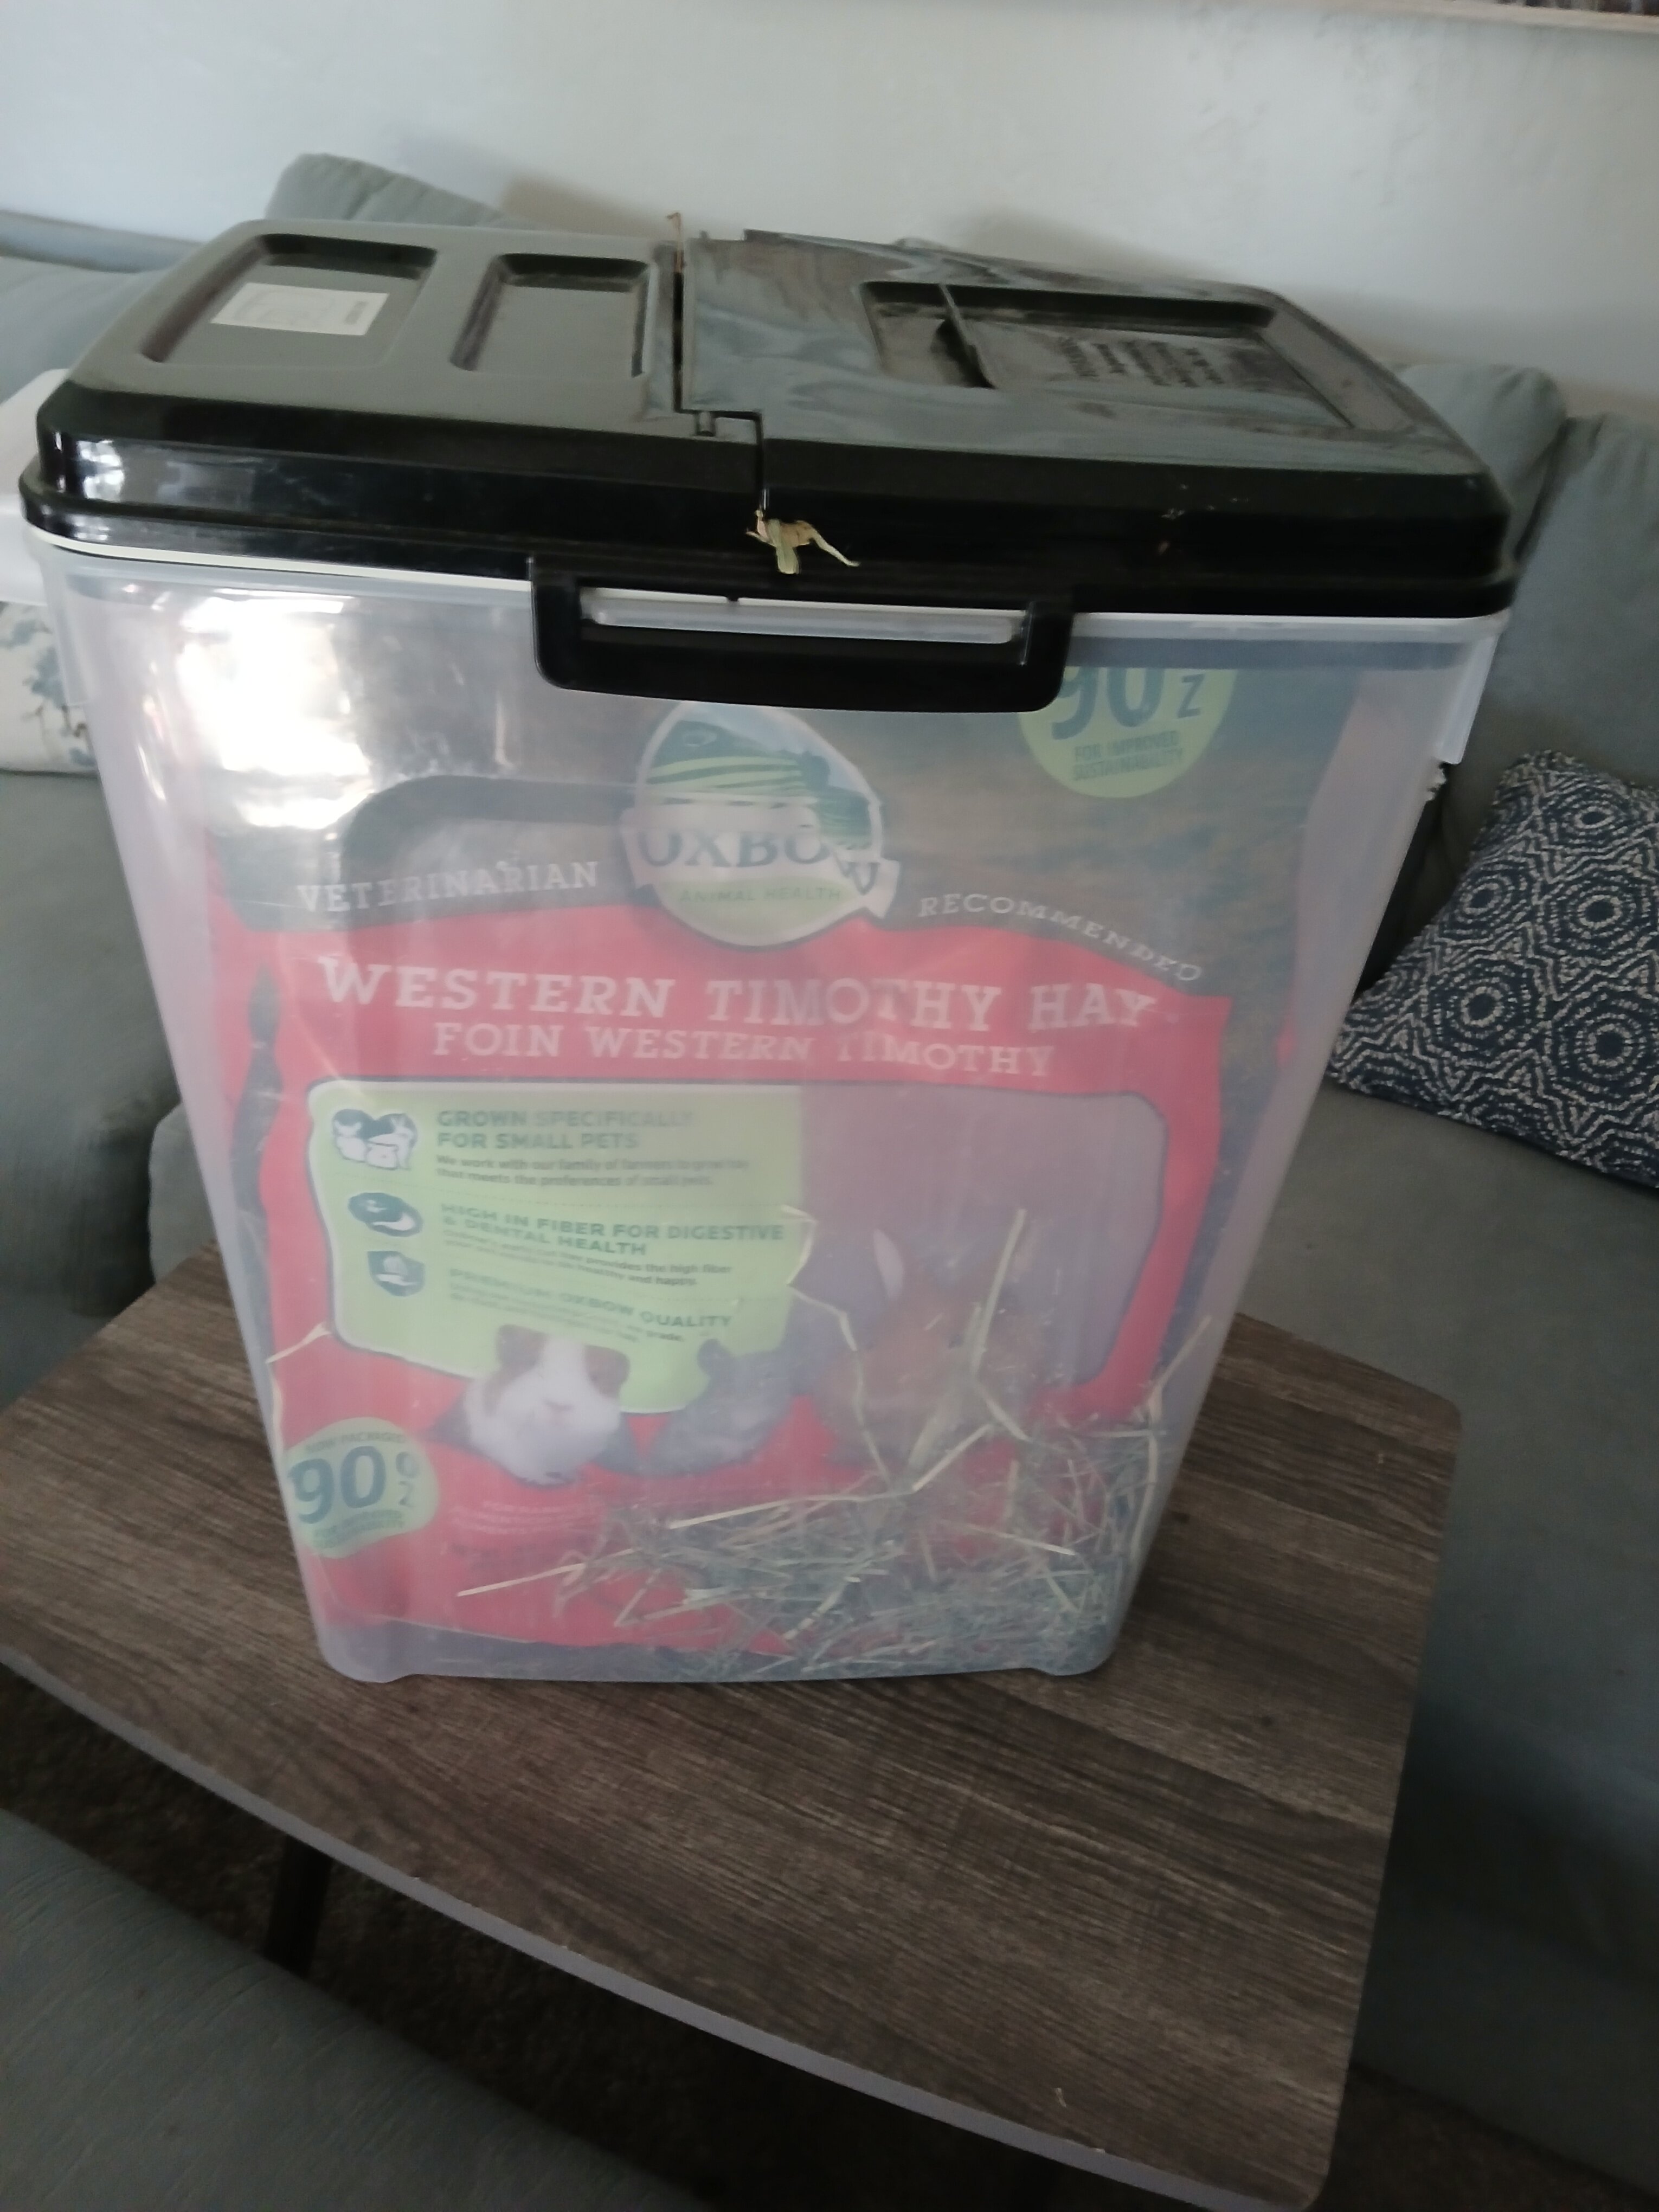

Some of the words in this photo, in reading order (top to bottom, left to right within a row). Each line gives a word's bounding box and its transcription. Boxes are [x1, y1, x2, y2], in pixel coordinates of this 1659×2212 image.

[297, 860, 598, 912] VETERINARIAN
[679, 888, 757, 902] ANIMAL
[763, 886, 841, 902] HEALTH
[918, 893, 1203, 981] RECOMMENDED
[318, 956, 676, 1018] WESTERN
[706, 978, 1002, 1031] TIMOTHY
[1028, 982, 1156, 1032] HAY
[432, 1022, 564, 1057] FOIN
[585, 1026, 816, 1060] WESTERN
[838, 1030, 1054, 1077] TIMOTHY
[437, 1111, 527, 1128] GROWN
[534, 1110, 694, 1128] SPECIFICALLY
[438, 1132, 487, 1149] FOR
[494, 1133, 573, 1149] SMALL
[581, 1133, 640, 1149] PETS
[441, 1204, 497, 1220] HIGH
[505, 1214, 529, 1227] IN
[537, 1218, 605, 1236] FIBER
[613, 1224, 659, 1238] FOR
[667, 1225, 784, 1240] DIGESTIVE
[464, 1219, 550, 1244] DENTAL
[557, 1236, 647, 1255] HEALTH
[639, 1310, 732, 1327] QUALITY
[287, 1446, 387, 1524] 90
